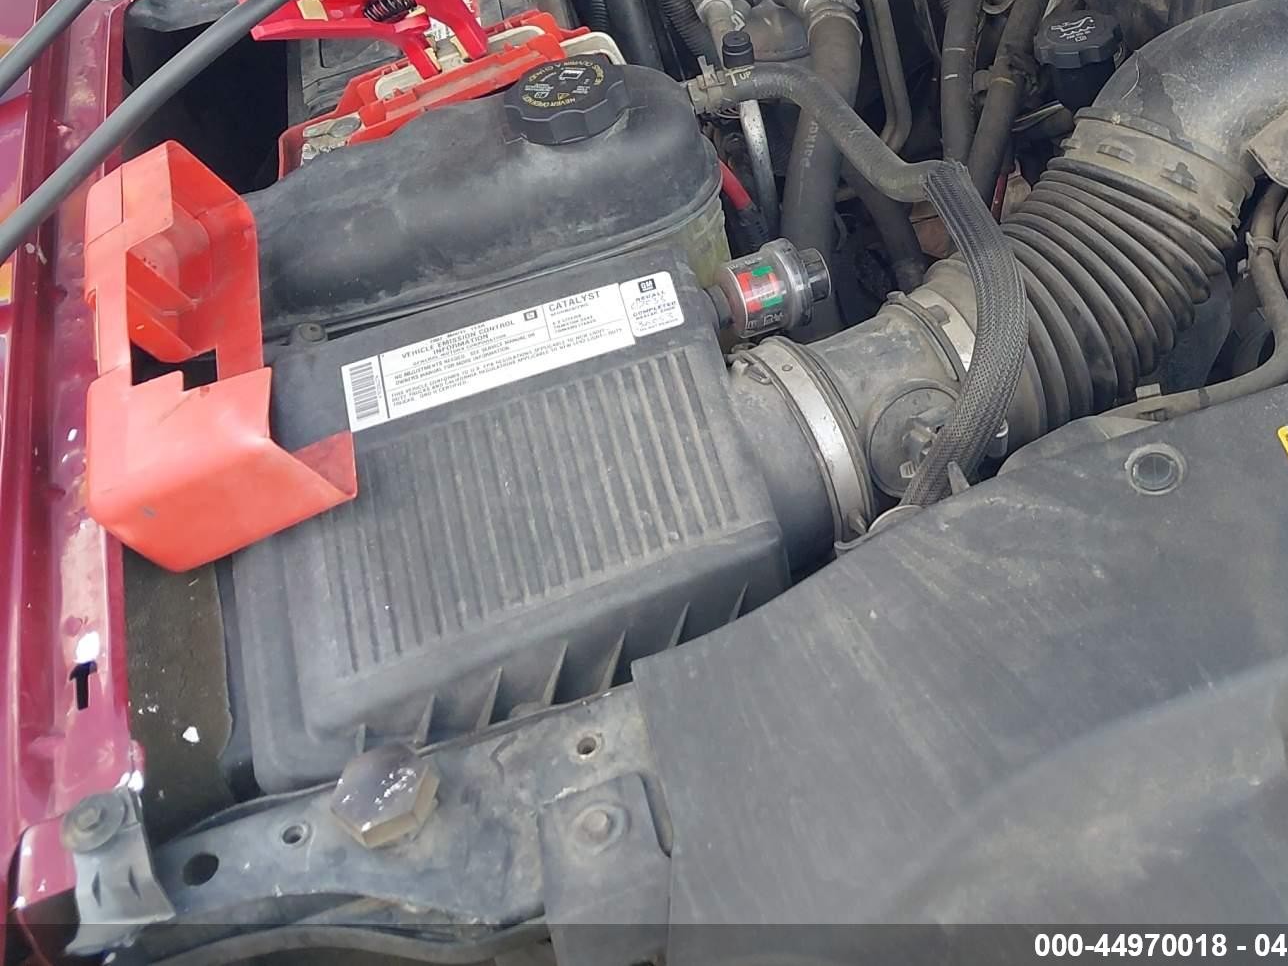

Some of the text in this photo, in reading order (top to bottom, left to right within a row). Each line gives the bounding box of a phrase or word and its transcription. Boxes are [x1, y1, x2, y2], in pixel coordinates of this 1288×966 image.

[550, 96, 576, 108] NEVER
[549, 289, 600, 313] CATALYST
[402, 344, 434, 359] VEHICLE
[438, 331, 475, 348] EMISSION
[478, 319, 515, 335] CONTROL
[434, 333, 488, 355] INFORMATION
